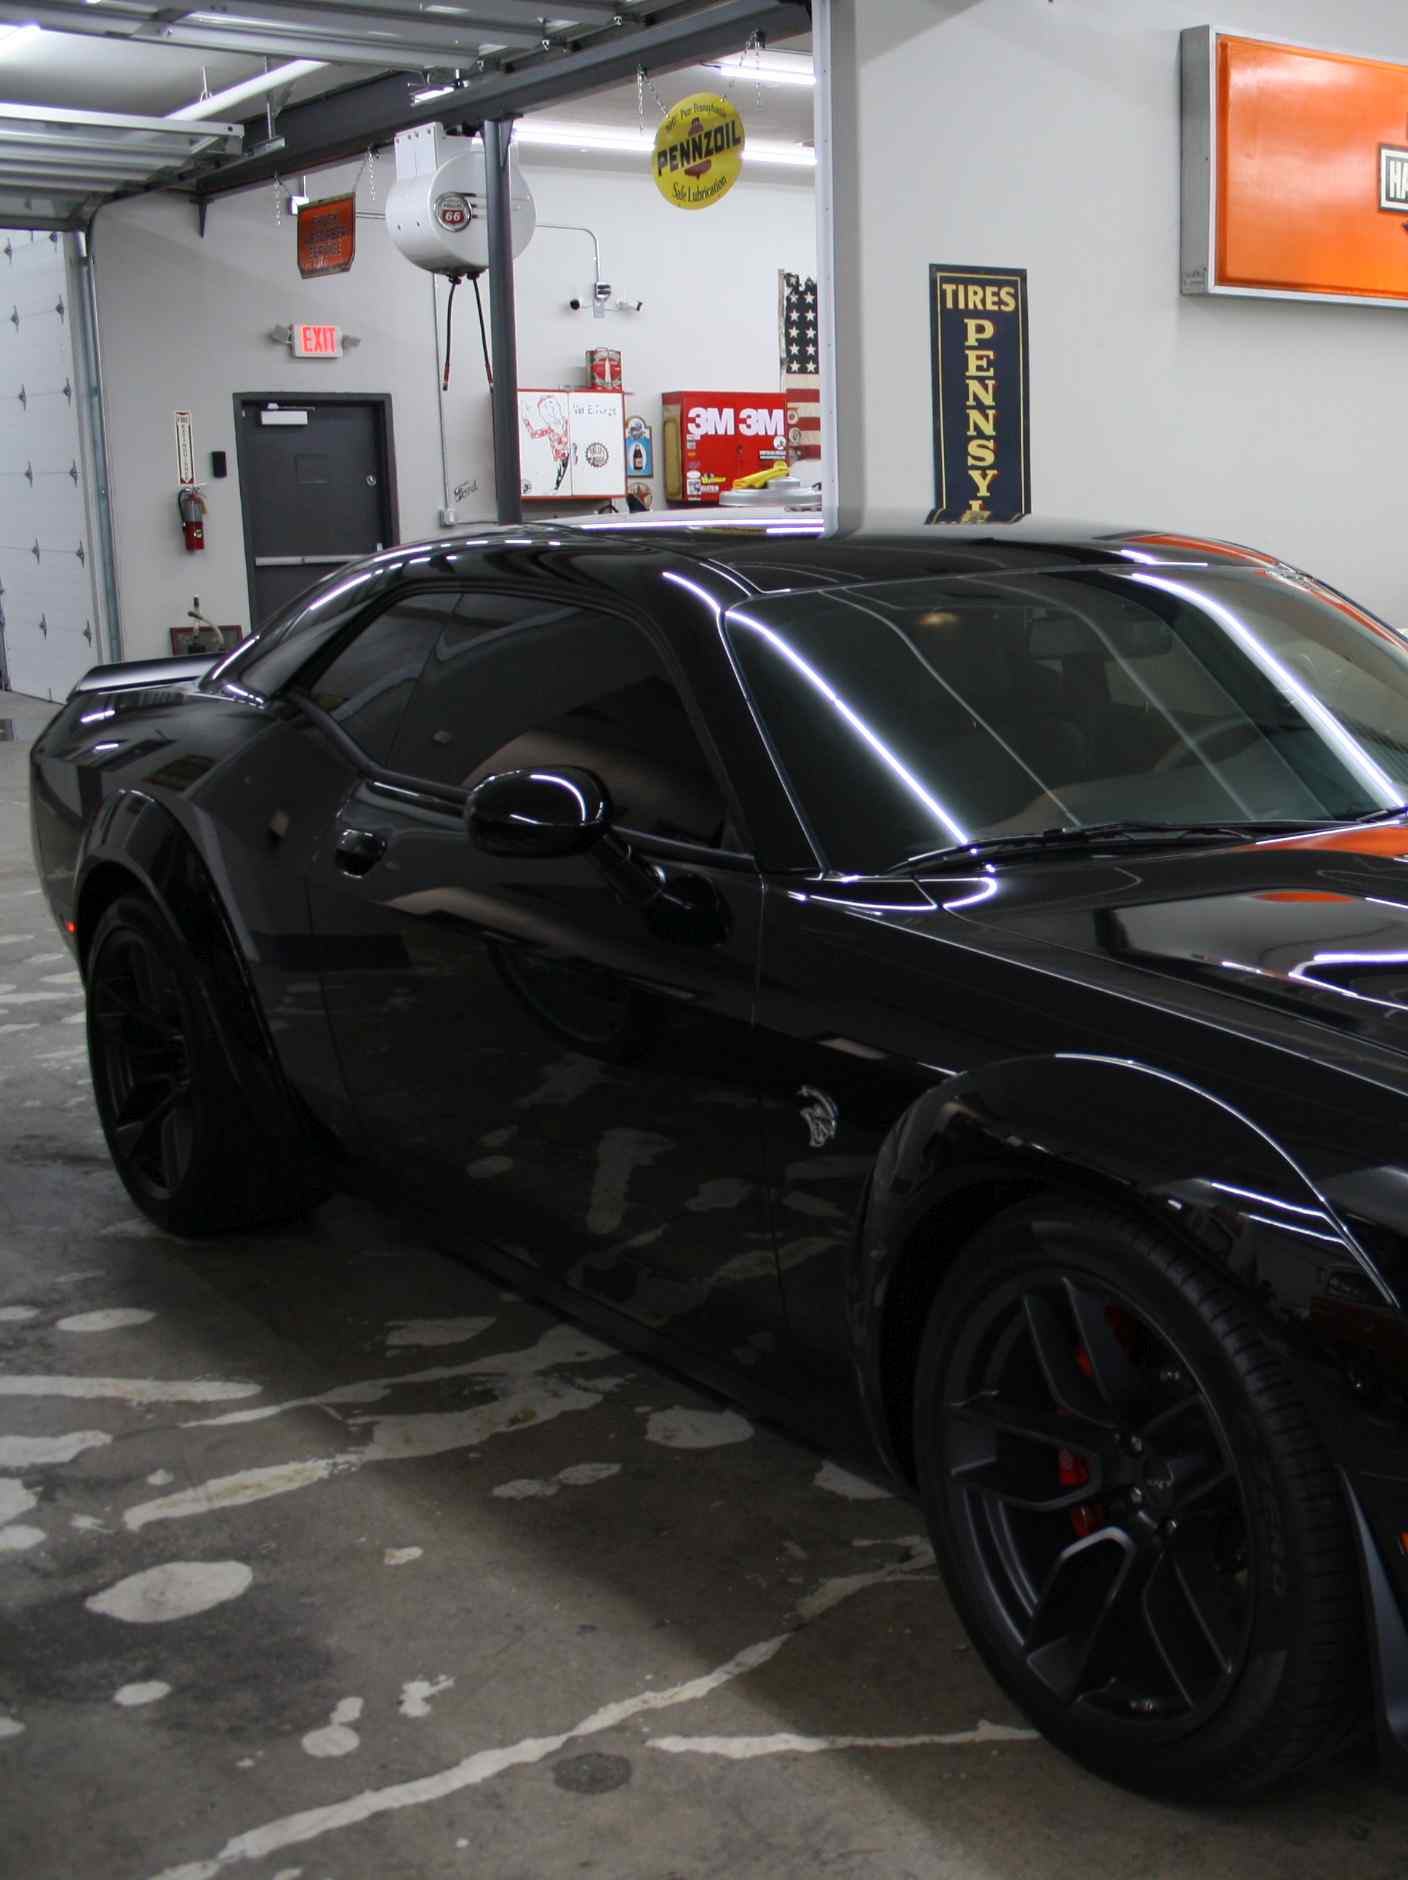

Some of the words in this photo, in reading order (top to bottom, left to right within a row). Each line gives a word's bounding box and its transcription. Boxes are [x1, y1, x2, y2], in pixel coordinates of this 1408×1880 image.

[657, 119, 741, 177] PENNZOIL
[445, 211, 461, 222] 66
[942, 283, 1016, 312] TIRES
[303, 327, 337, 352] EXIT
[687, 407, 736, 438] 3M
[739, 408, 785, 436] 3M
